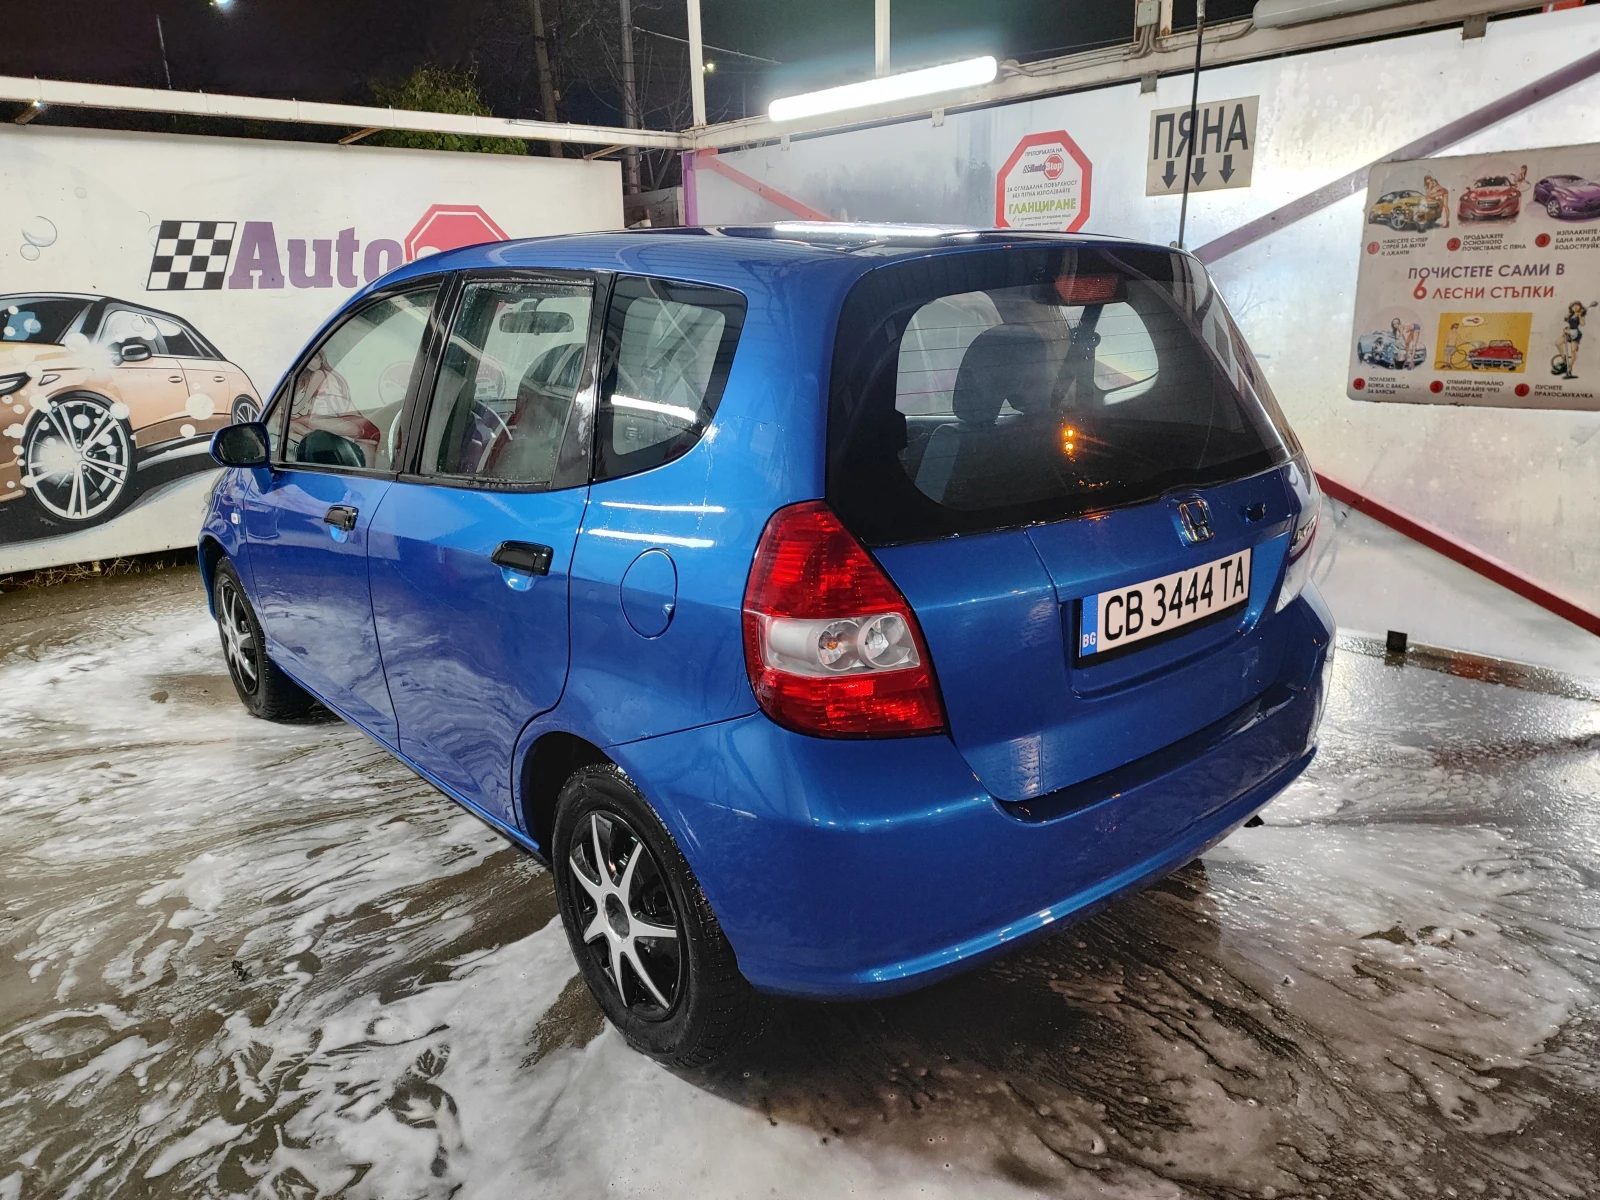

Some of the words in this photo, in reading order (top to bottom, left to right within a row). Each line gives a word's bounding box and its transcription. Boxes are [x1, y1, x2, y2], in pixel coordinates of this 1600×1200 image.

[1153, 103, 1248, 160] ПЯНА
[1037, 187, 1071, 196] ИЗПОЛЗВАЙТЕ
[1044, 180, 1077, 188] ПОВЪРХНОСТ
[1008, 198, 1077, 214] ГЛАНЦИРАНЕ
[228, 221, 403, 289] Auto
[1408, 266, 1493, 279] ПОЧИСТЕТЕ
[1498, 264, 1549, 277] САМИ
[1556, 263, 1565, 276] В
[1413, 278, 1427, 300] 6
[1432, 287, 1485, 299] ЛЕСНИ
[1490, 286, 1555, 299] СТЪПКИ
[1105, 590, 1144, 641] CB
[1151, 567, 1213, 627] 3444
[1220, 556, 1244, 602] TA
[1082, 632, 1097, 648] BG
